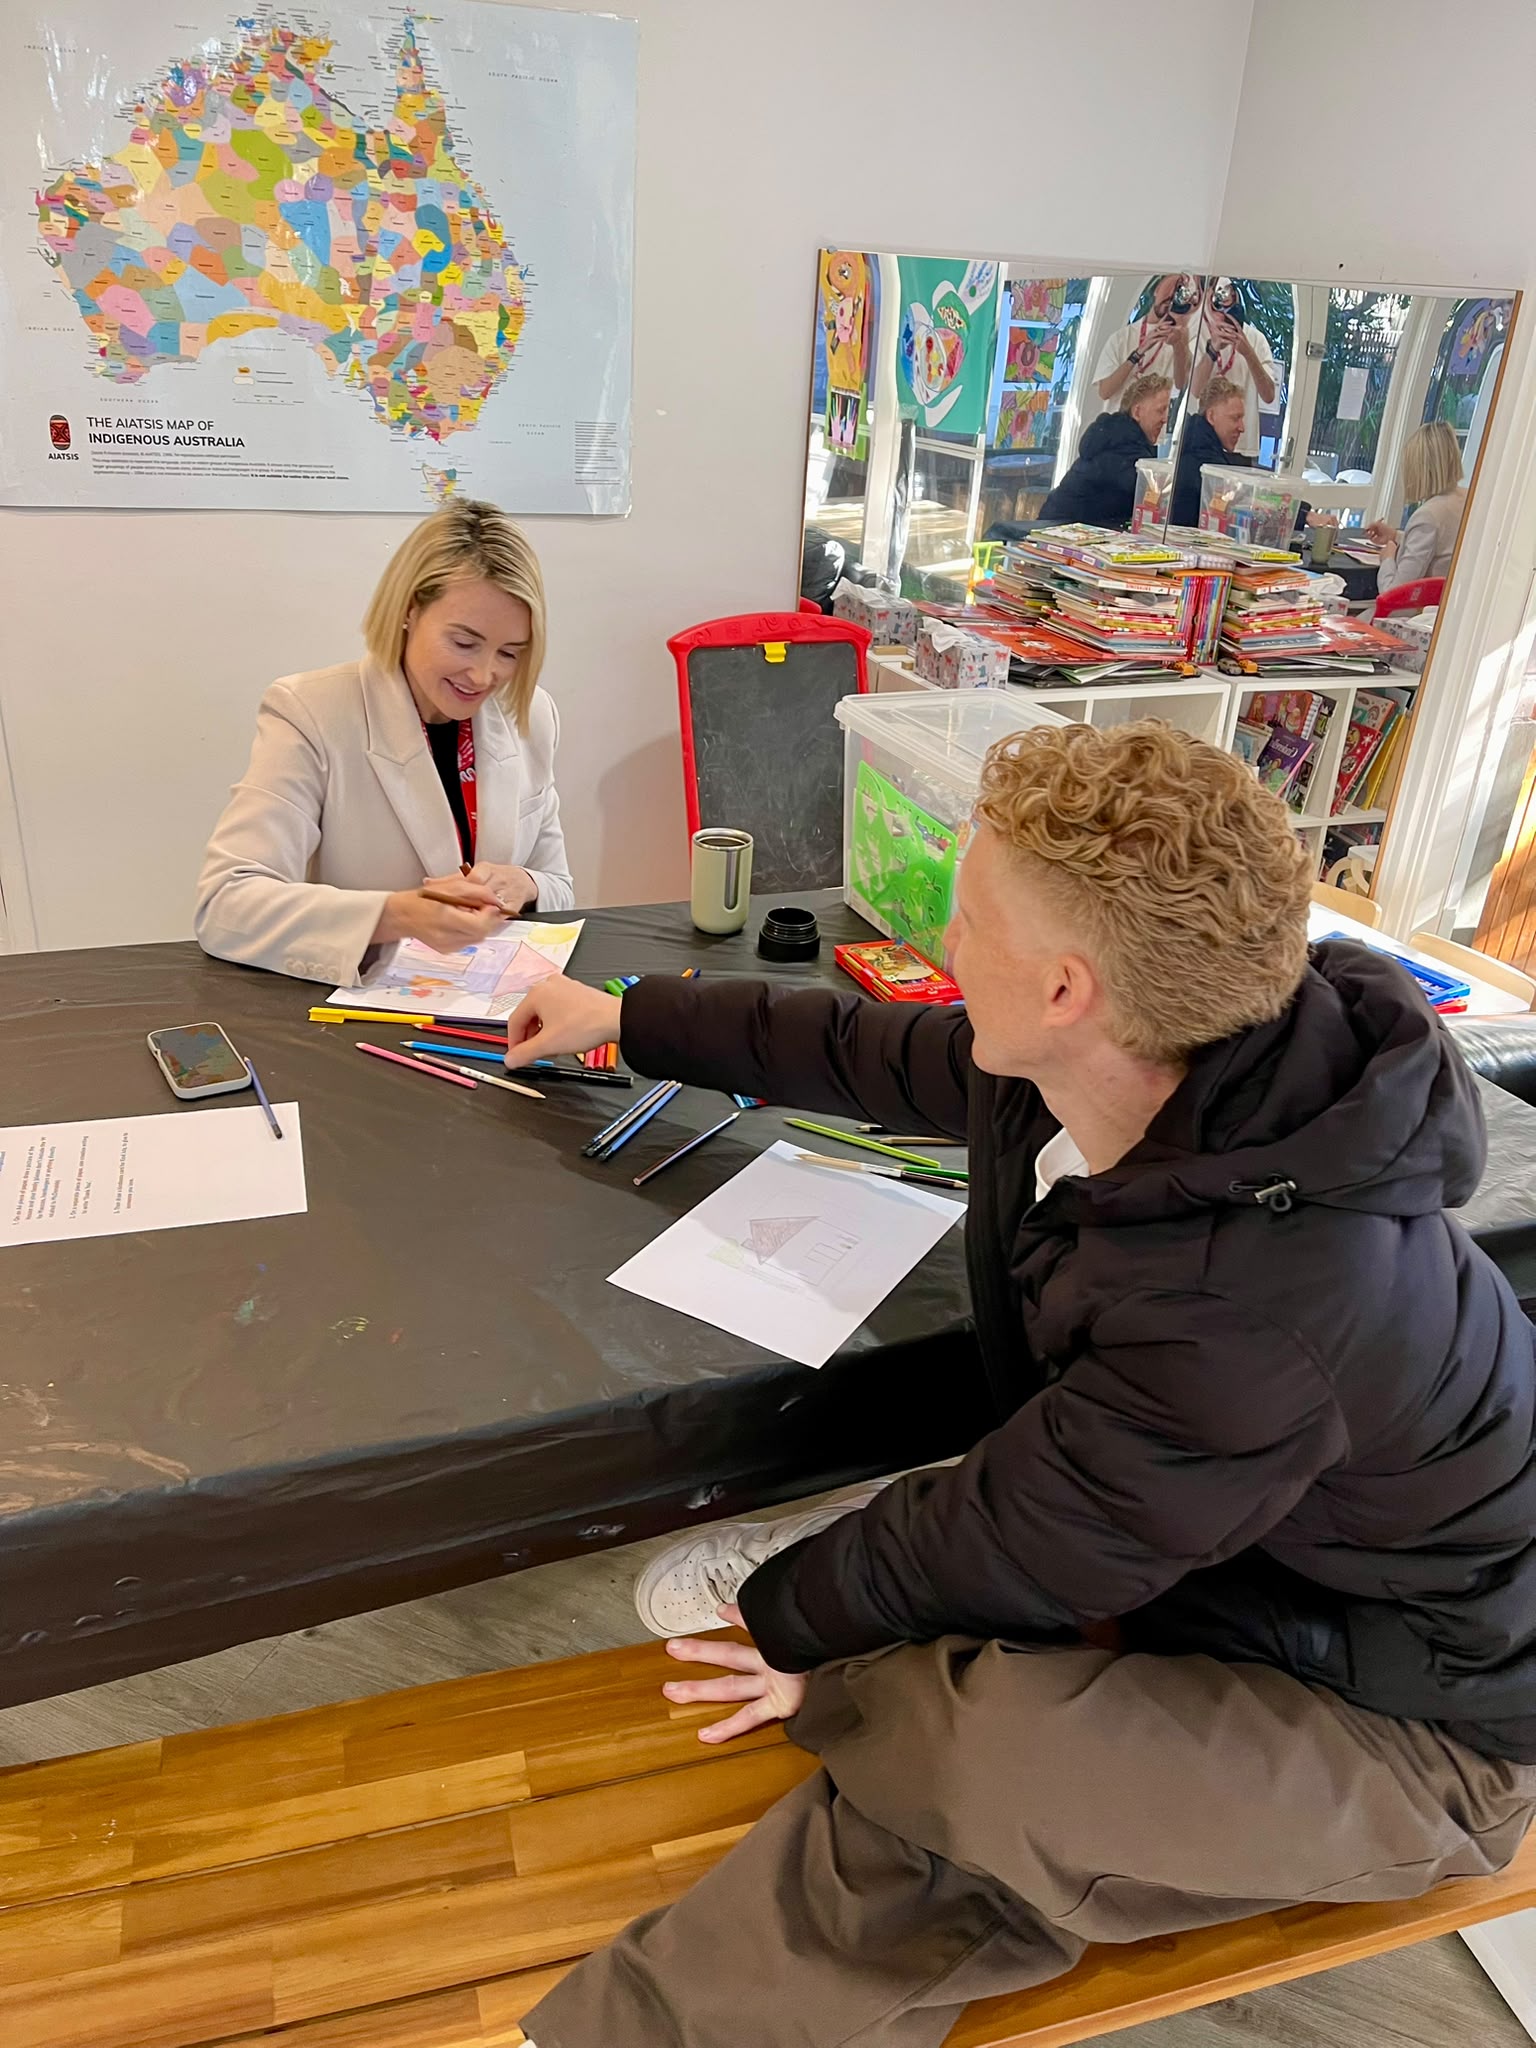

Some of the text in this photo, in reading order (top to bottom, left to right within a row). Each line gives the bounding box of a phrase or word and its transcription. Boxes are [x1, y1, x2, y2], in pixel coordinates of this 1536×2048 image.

[87, 417, 213, 430] THE AIATSIS MAP OF
[89, 433, 245, 447] INDIGENOUS AUSTRALIA
